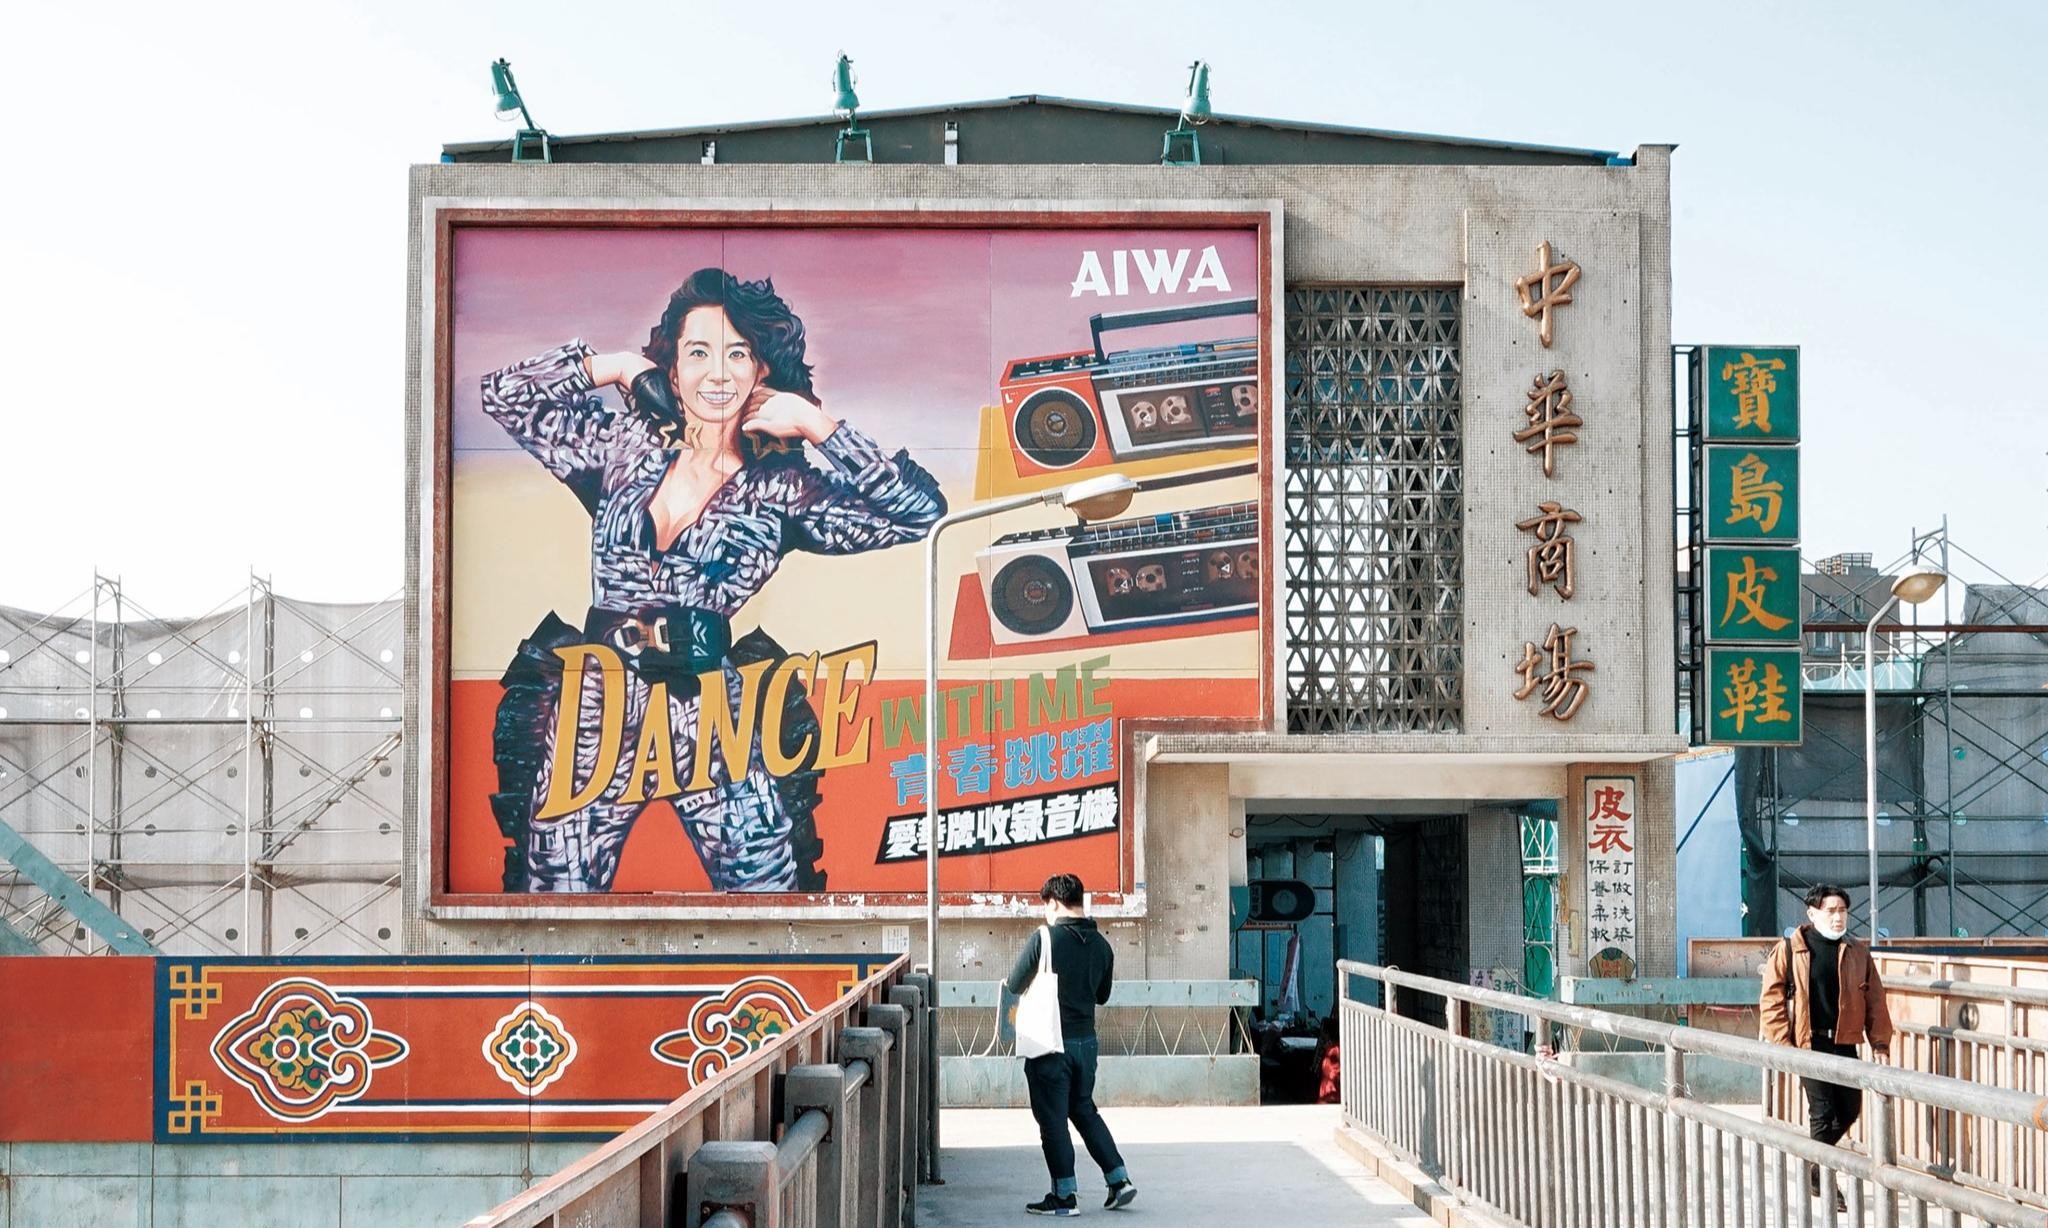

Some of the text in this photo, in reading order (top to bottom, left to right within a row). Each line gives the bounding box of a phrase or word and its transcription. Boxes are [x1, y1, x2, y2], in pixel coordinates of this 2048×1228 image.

[1071, 245, 1232, 298] AIWA
[1718, 352, 1794, 734] 寶島皮鞋
[535, 640, 1113, 820] DANCE WITH ME
[890, 717, 1115, 806] 青春跳躍
[885, 786, 1118, 859] 愛華牌收錄音機
[1588, 786, 1633, 853] 皮衣
